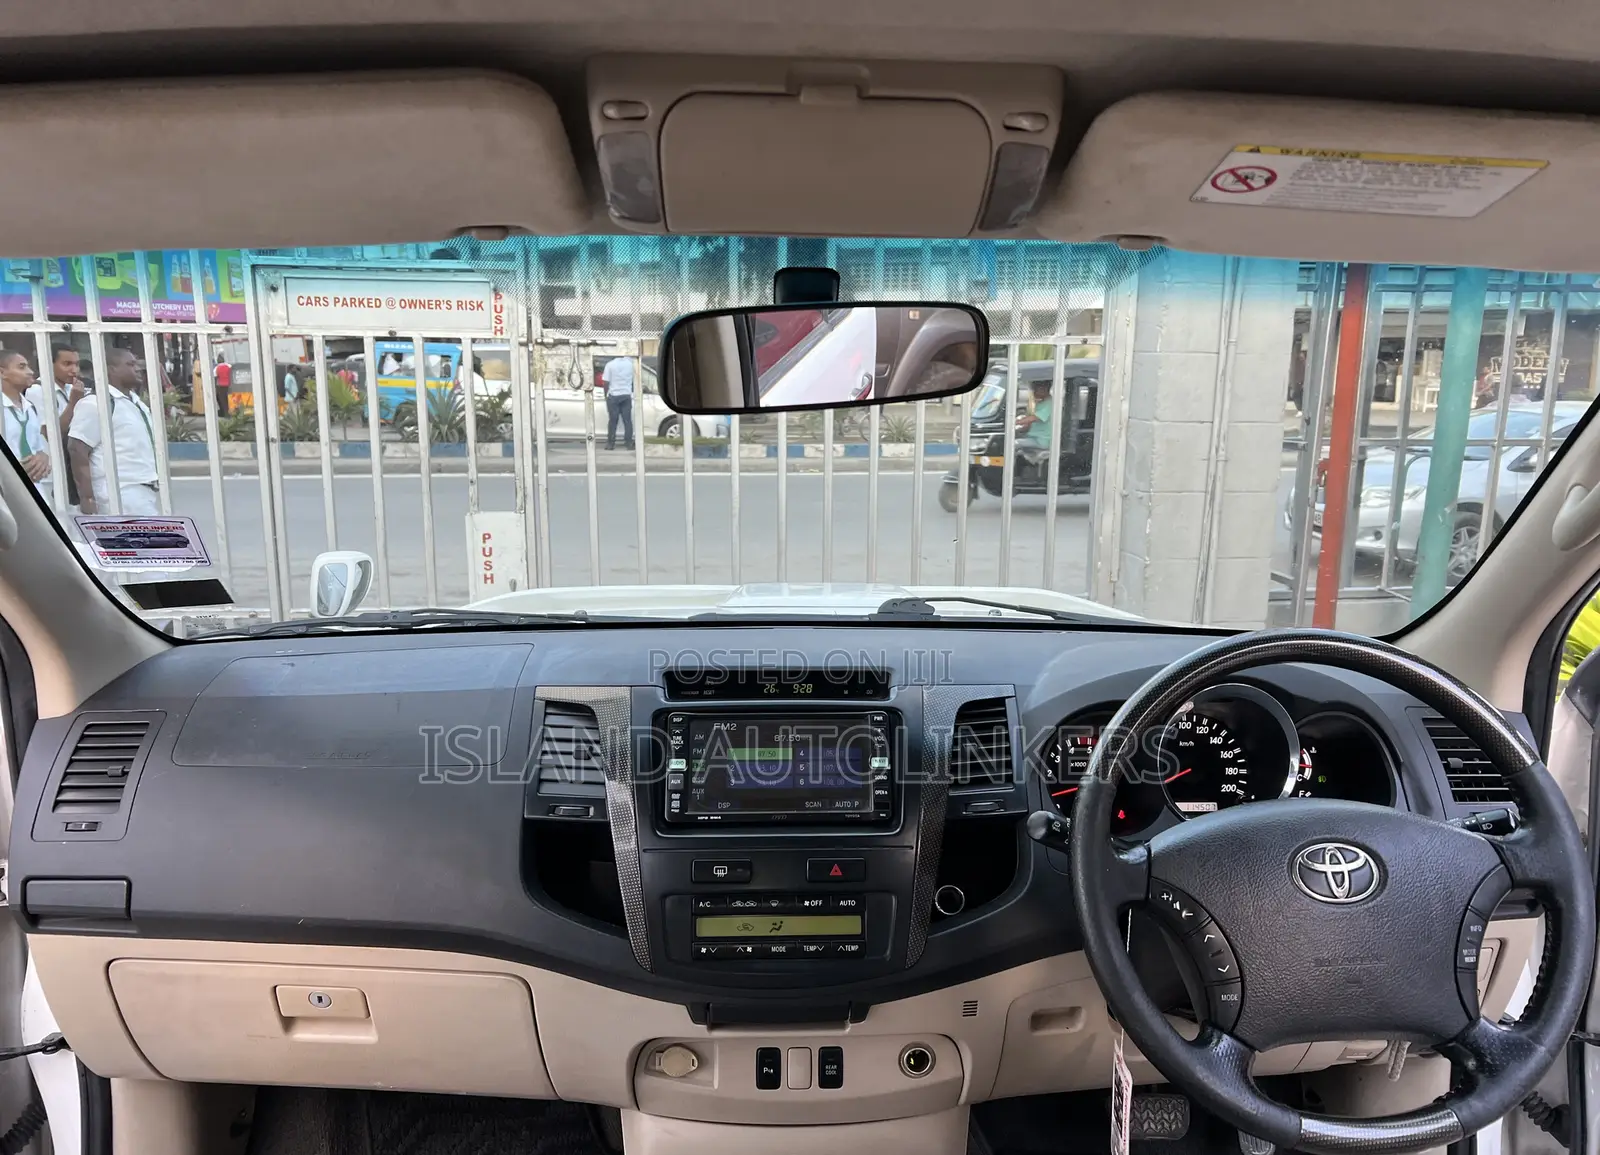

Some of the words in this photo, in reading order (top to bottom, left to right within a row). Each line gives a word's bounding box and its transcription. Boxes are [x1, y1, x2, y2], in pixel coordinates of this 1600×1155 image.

[297, 296, 329, 307] CARS
[333, 297, 382, 309] PARKED
[385, 297, 397, 310] @
[399, 298, 452, 310] OWNER'S
[456, 300, 484, 311] RISK
[493, 293, 504, 336] PUSH
[482, 532, 494, 584] PUSH
[714, 723, 737, 731] FM2
[1178, 721, 1192, 730] 100
[1196, 726, 1209, 734] 120
[1209, 736, 1223, 745] 140
[1087, 746, 1093, 754] 5
[1220, 750, 1234, 759] 160
[1054, 755, 1061, 763] 3
[1047, 769, 1053, 777] 2
[1225, 767, 1239, 776] 180
[1296, 773, 1303, 782] C
[1220, 784, 1237, 793] 200
[1298, 790, 1305, 798] F
